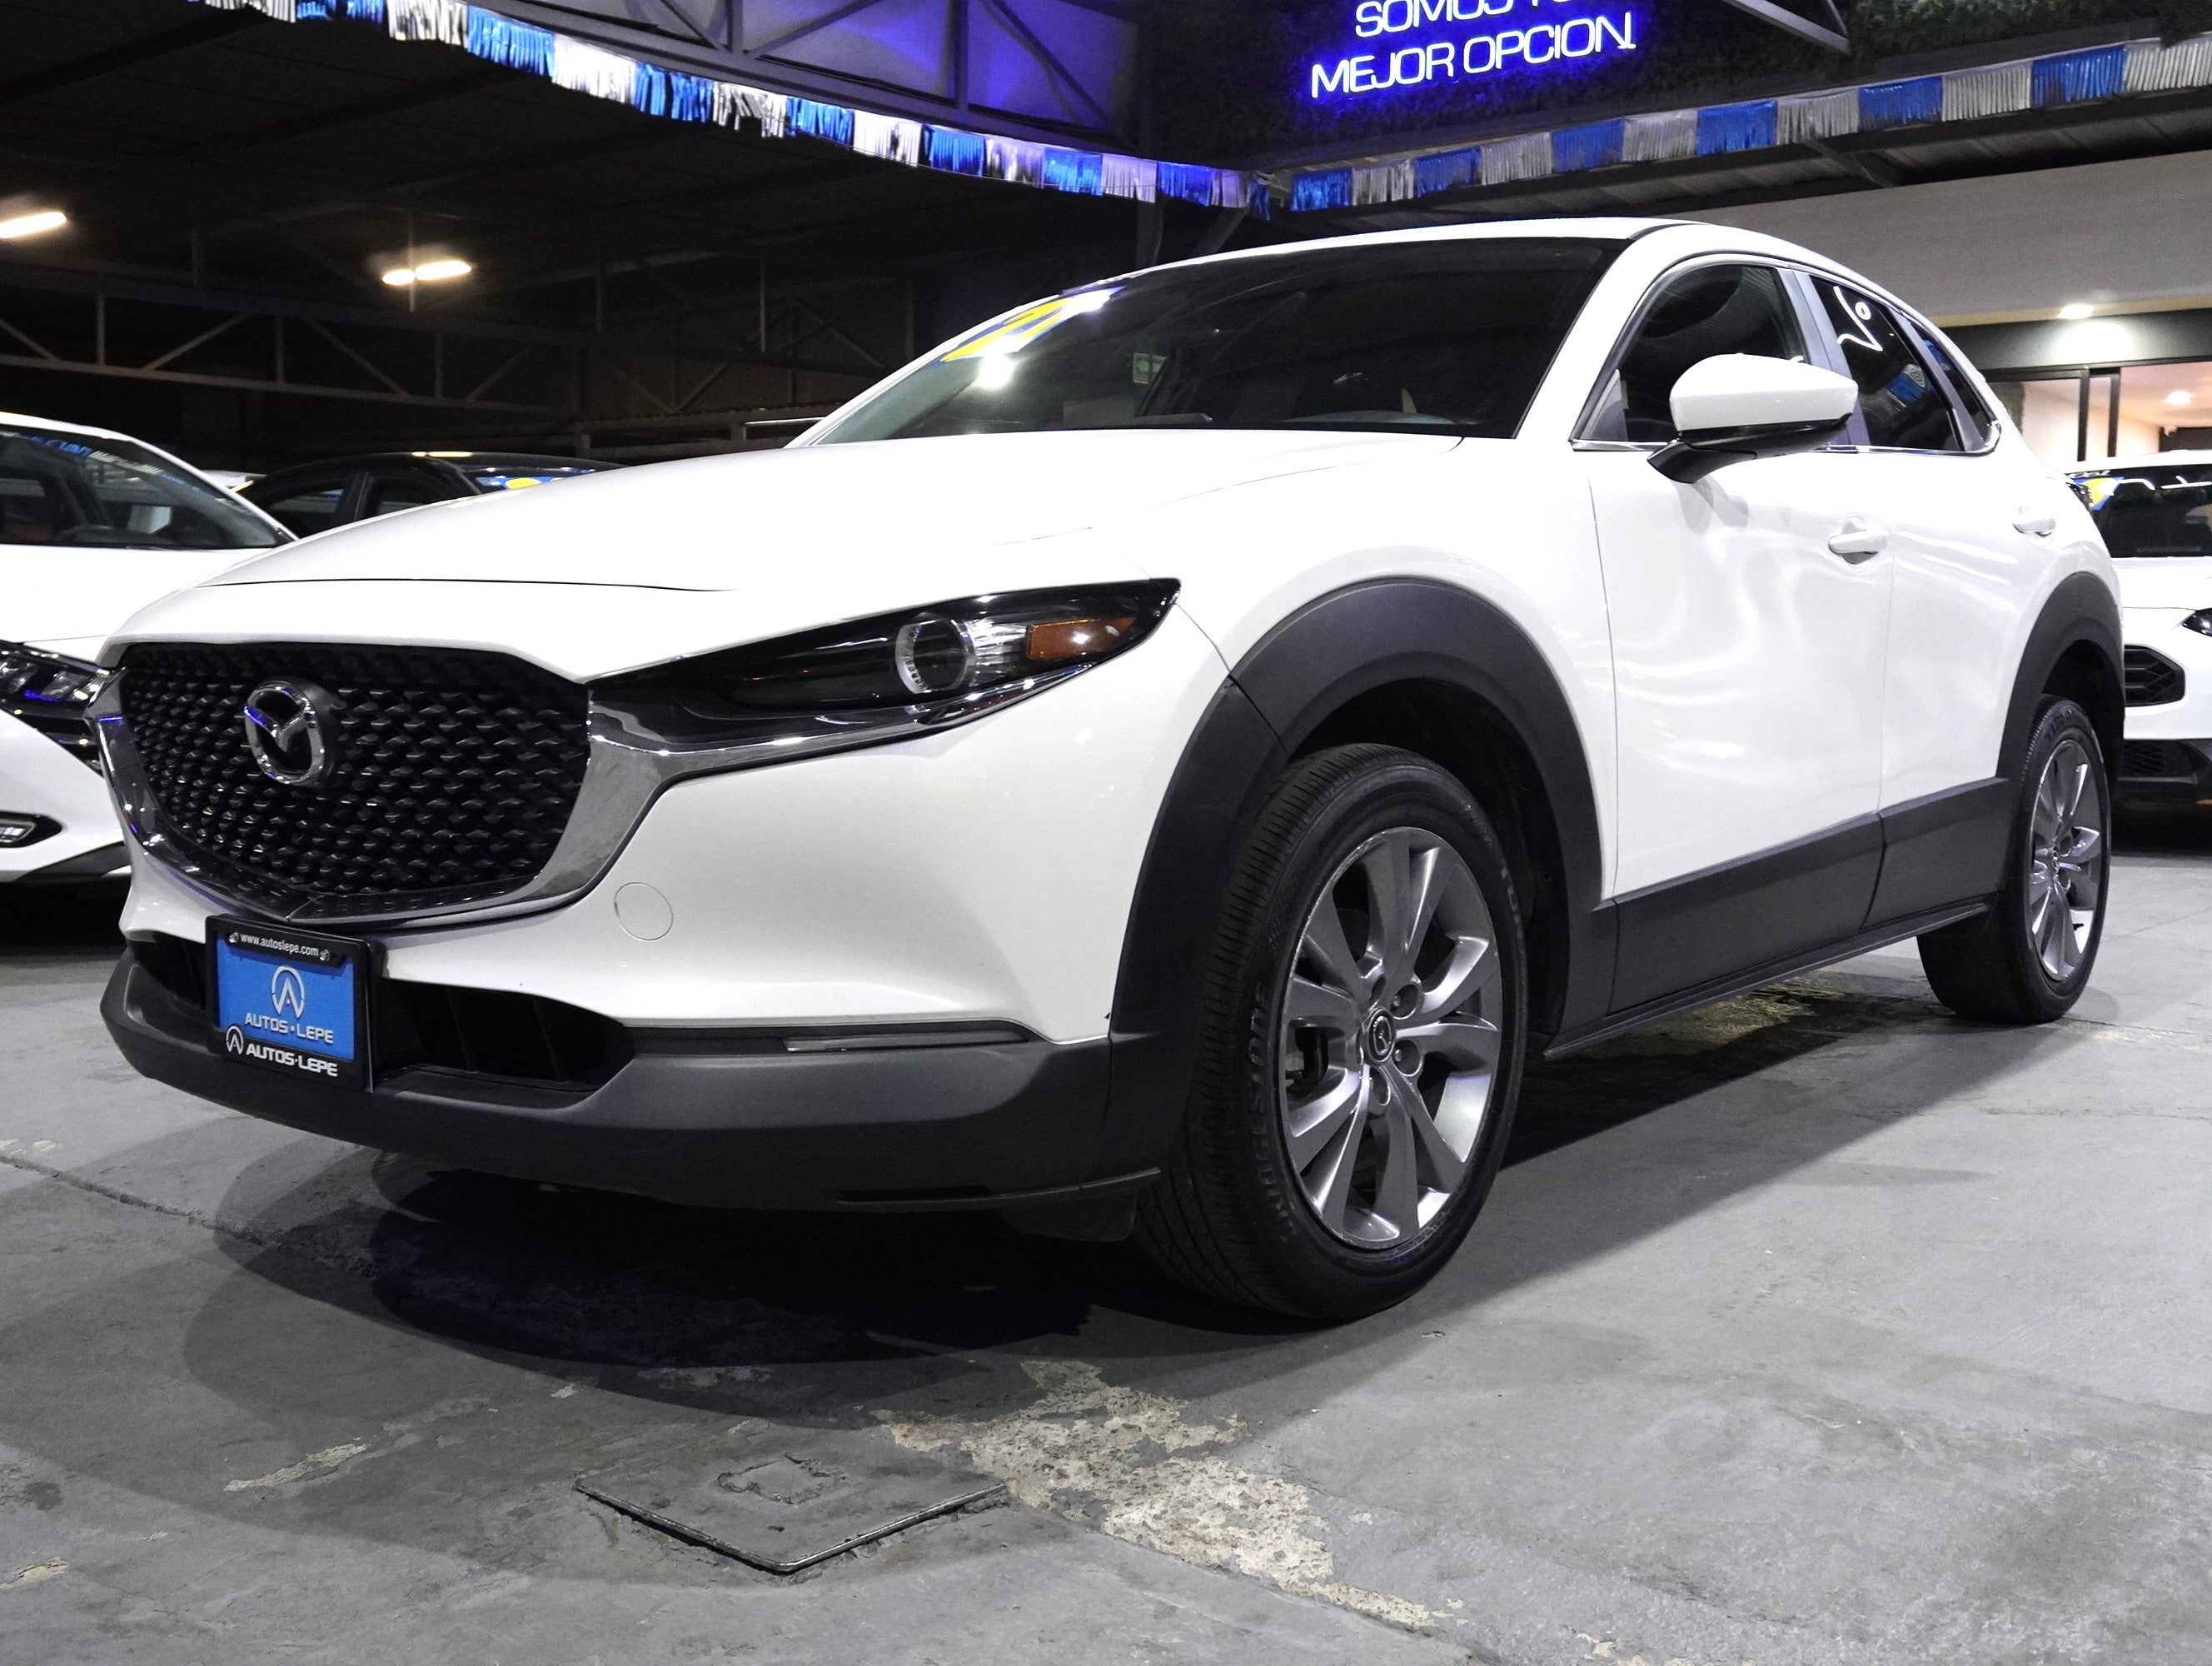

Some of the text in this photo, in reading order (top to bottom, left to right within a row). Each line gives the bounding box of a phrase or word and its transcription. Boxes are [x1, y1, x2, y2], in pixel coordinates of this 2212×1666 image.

[1311, 12, 1636, 97] MEJOR OPCION
[240, 934, 320, 956] www.autoslepe.com
